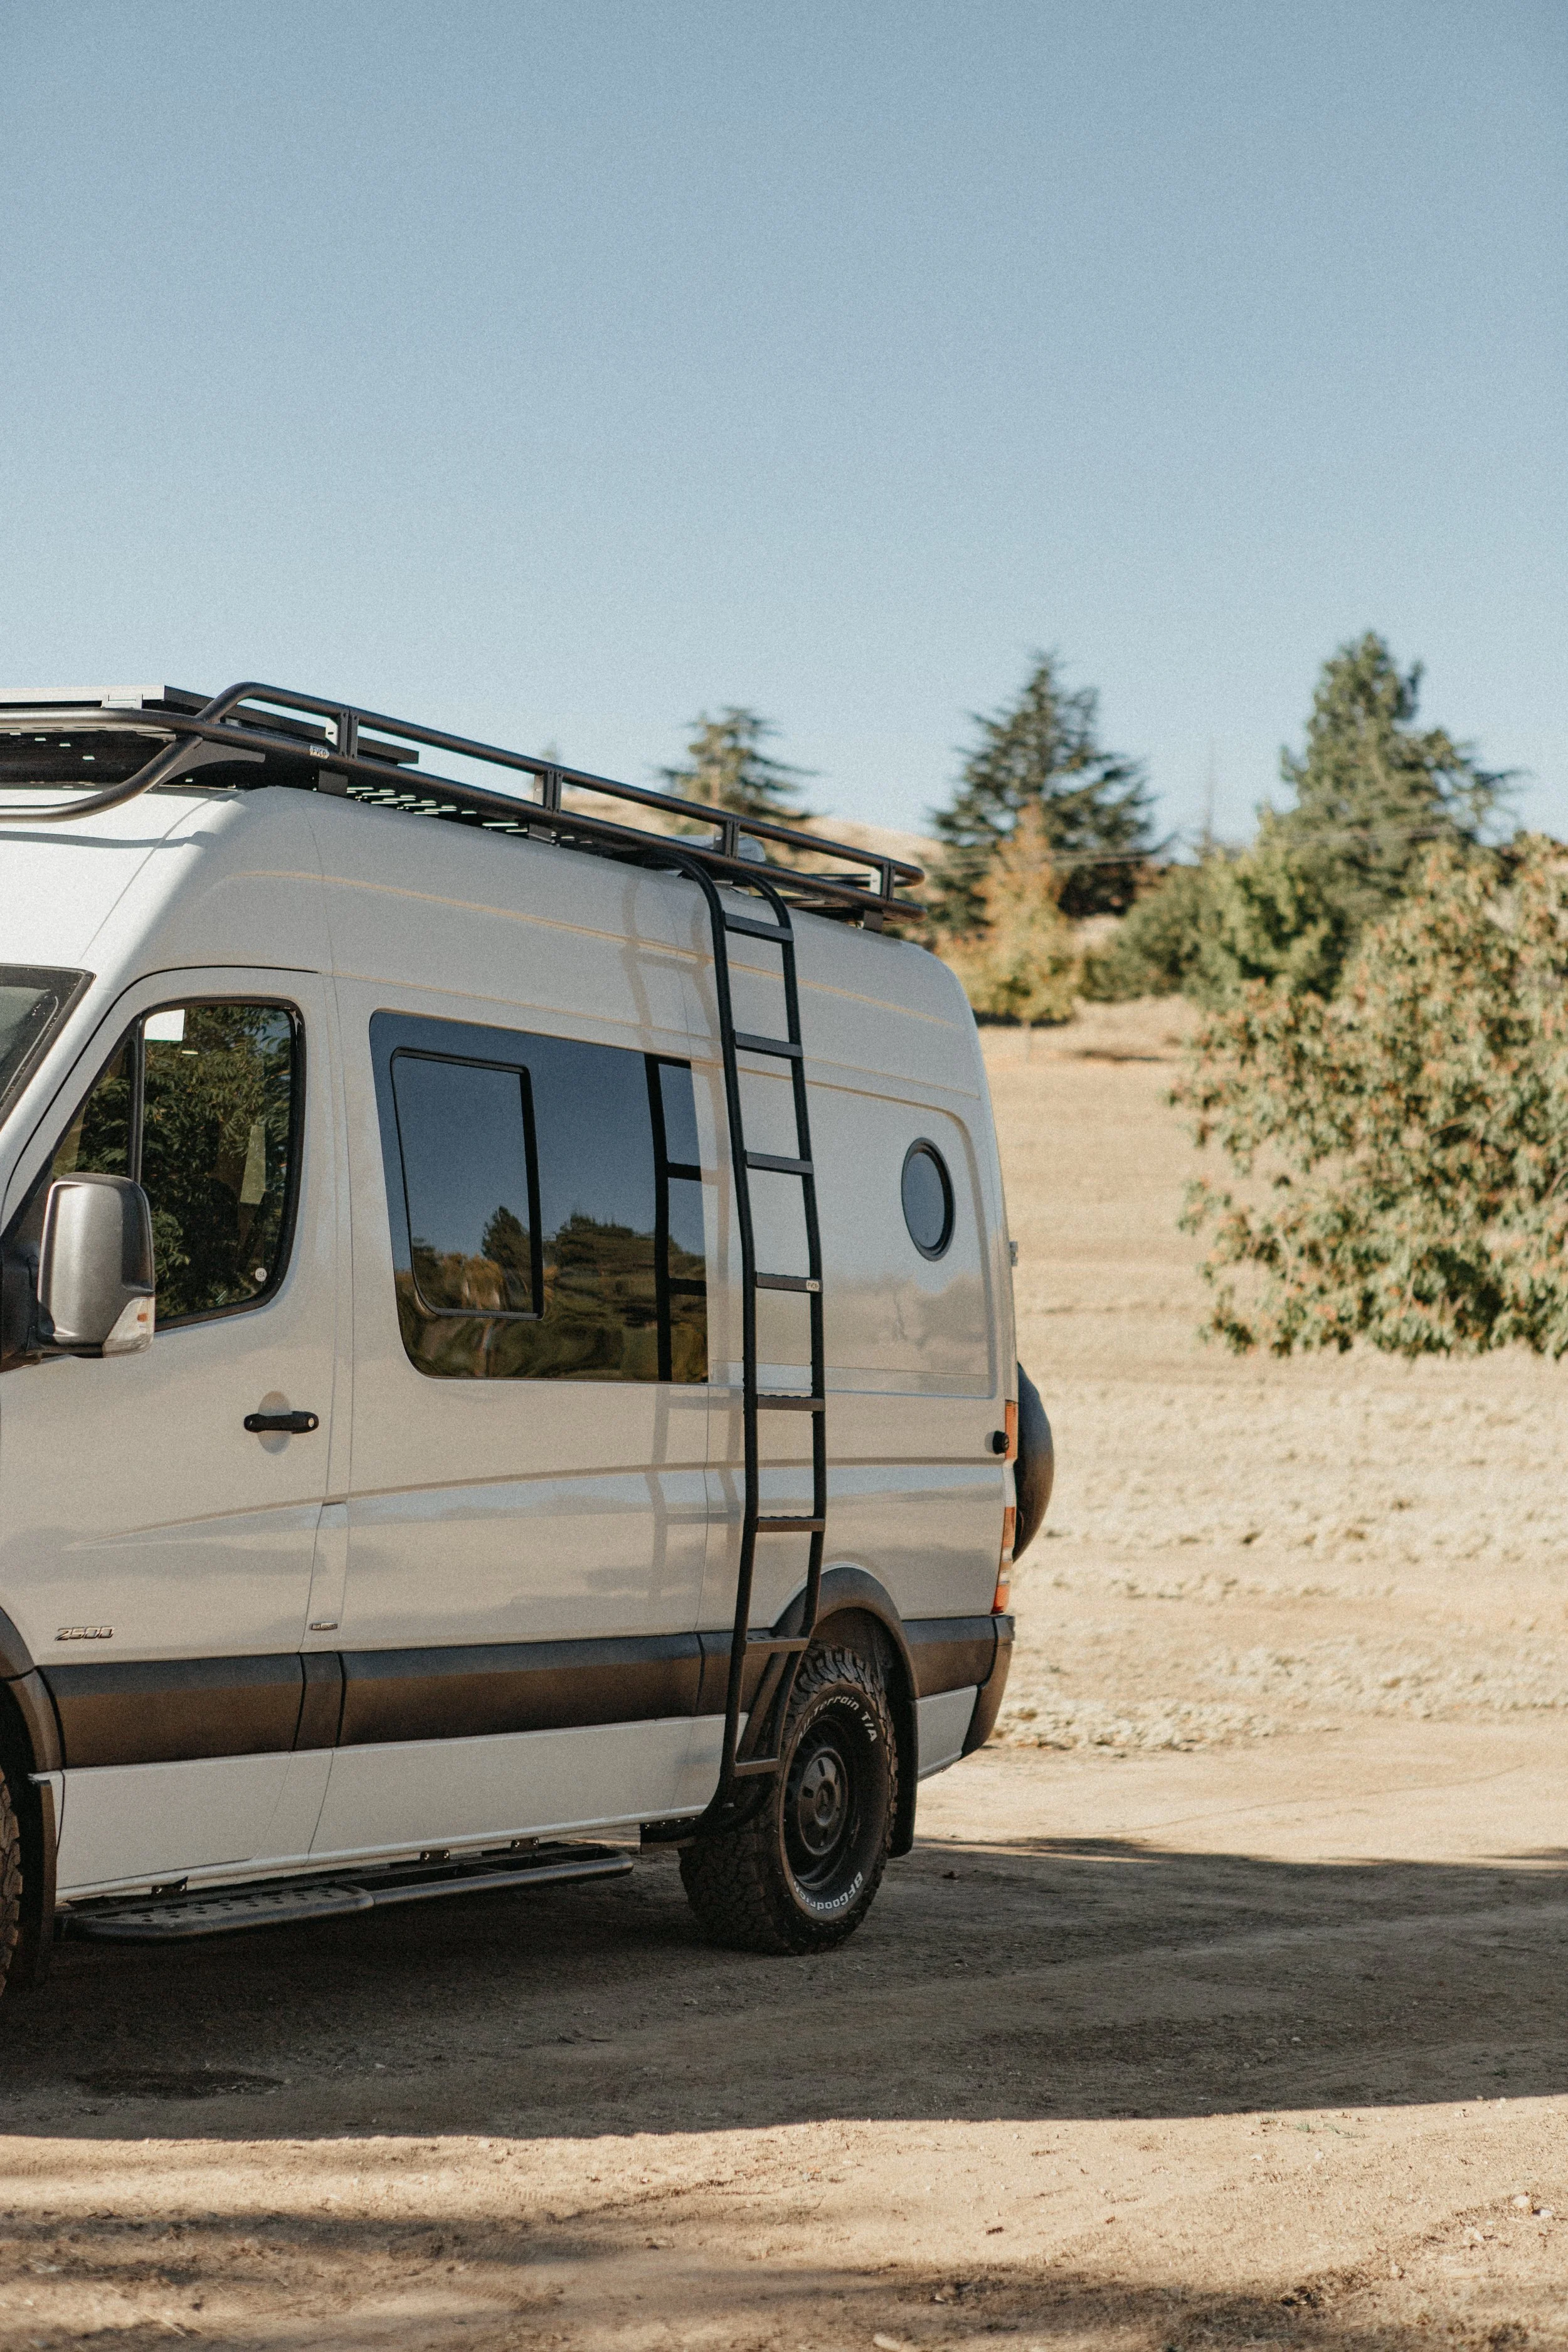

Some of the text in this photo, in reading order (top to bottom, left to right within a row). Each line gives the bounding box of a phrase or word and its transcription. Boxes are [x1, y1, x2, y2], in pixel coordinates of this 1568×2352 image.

[55, 1626, 114, 1641] 2500
[861, 1711, 877, 1742] T/A
[793, 1872, 863, 1910] BFGoodrich
